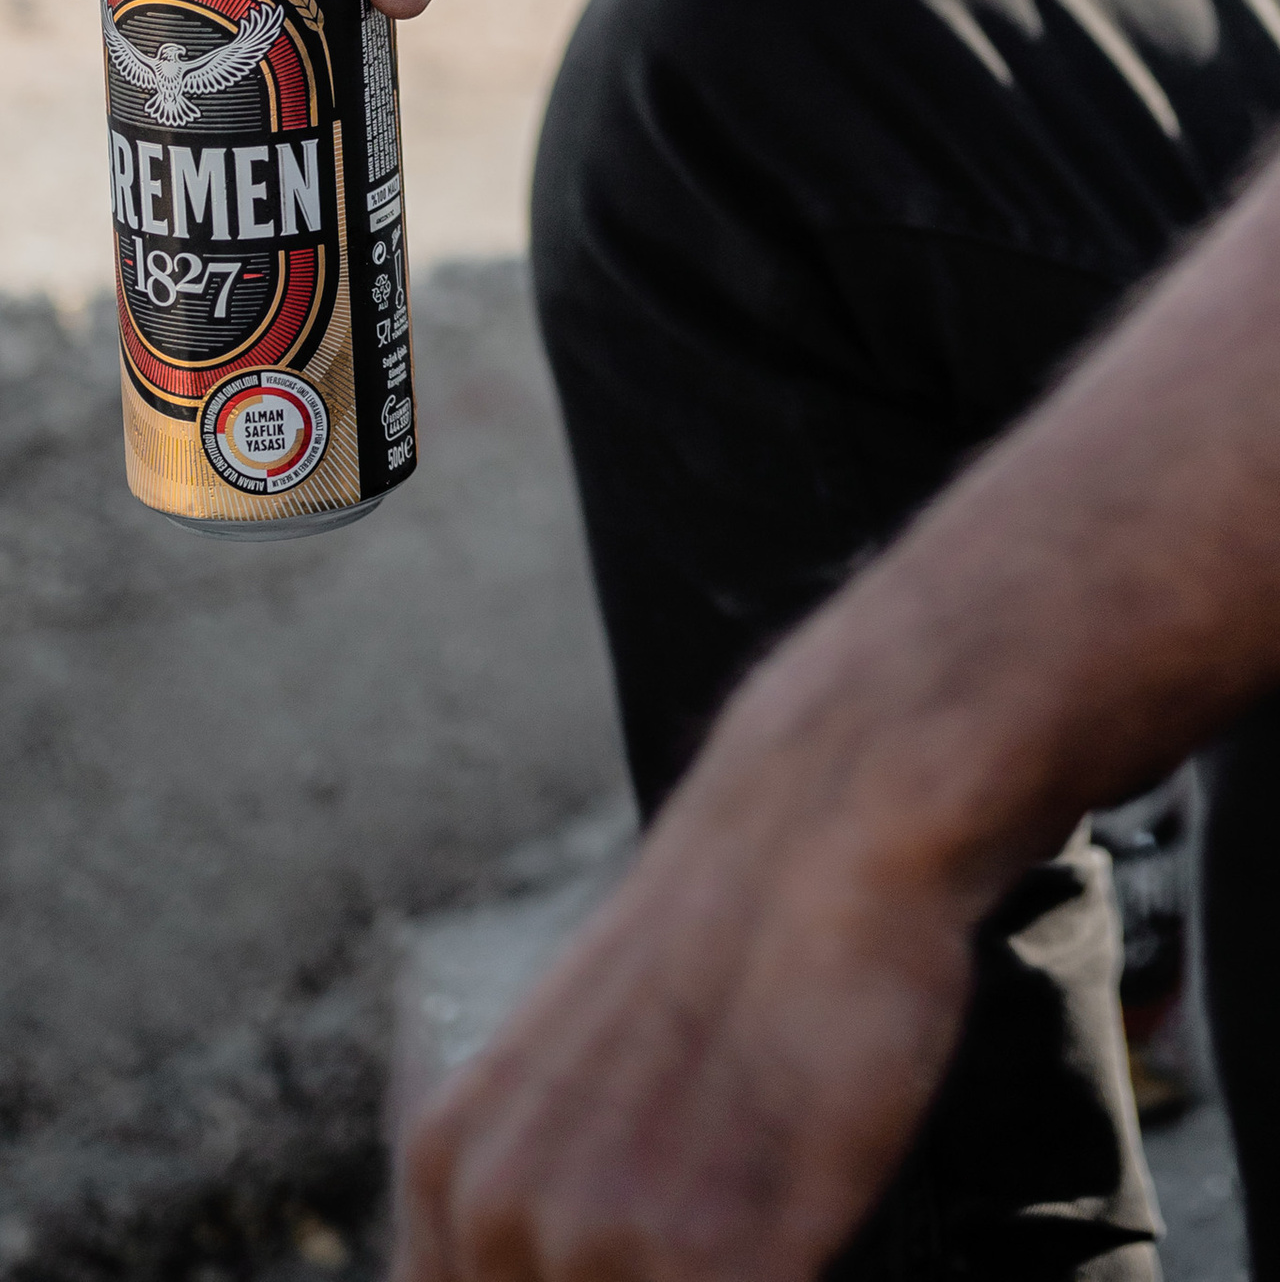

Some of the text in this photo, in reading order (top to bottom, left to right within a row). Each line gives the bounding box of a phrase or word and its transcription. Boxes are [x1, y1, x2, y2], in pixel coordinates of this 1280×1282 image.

[107, 129, 322, 240] REMEN
[371, 189, 386, 206] %100
[132, 235, 242, 318] 1827
[245, 409, 284, 424] ALMAN
[245, 424, 284, 438] SAFLIK
[246, 438, 285, 452] YASASI
[316, 434, 324, 445] FÜR
[224, 467, 239, 483] VLB
[239, 476, 265, 491] ALMAN
